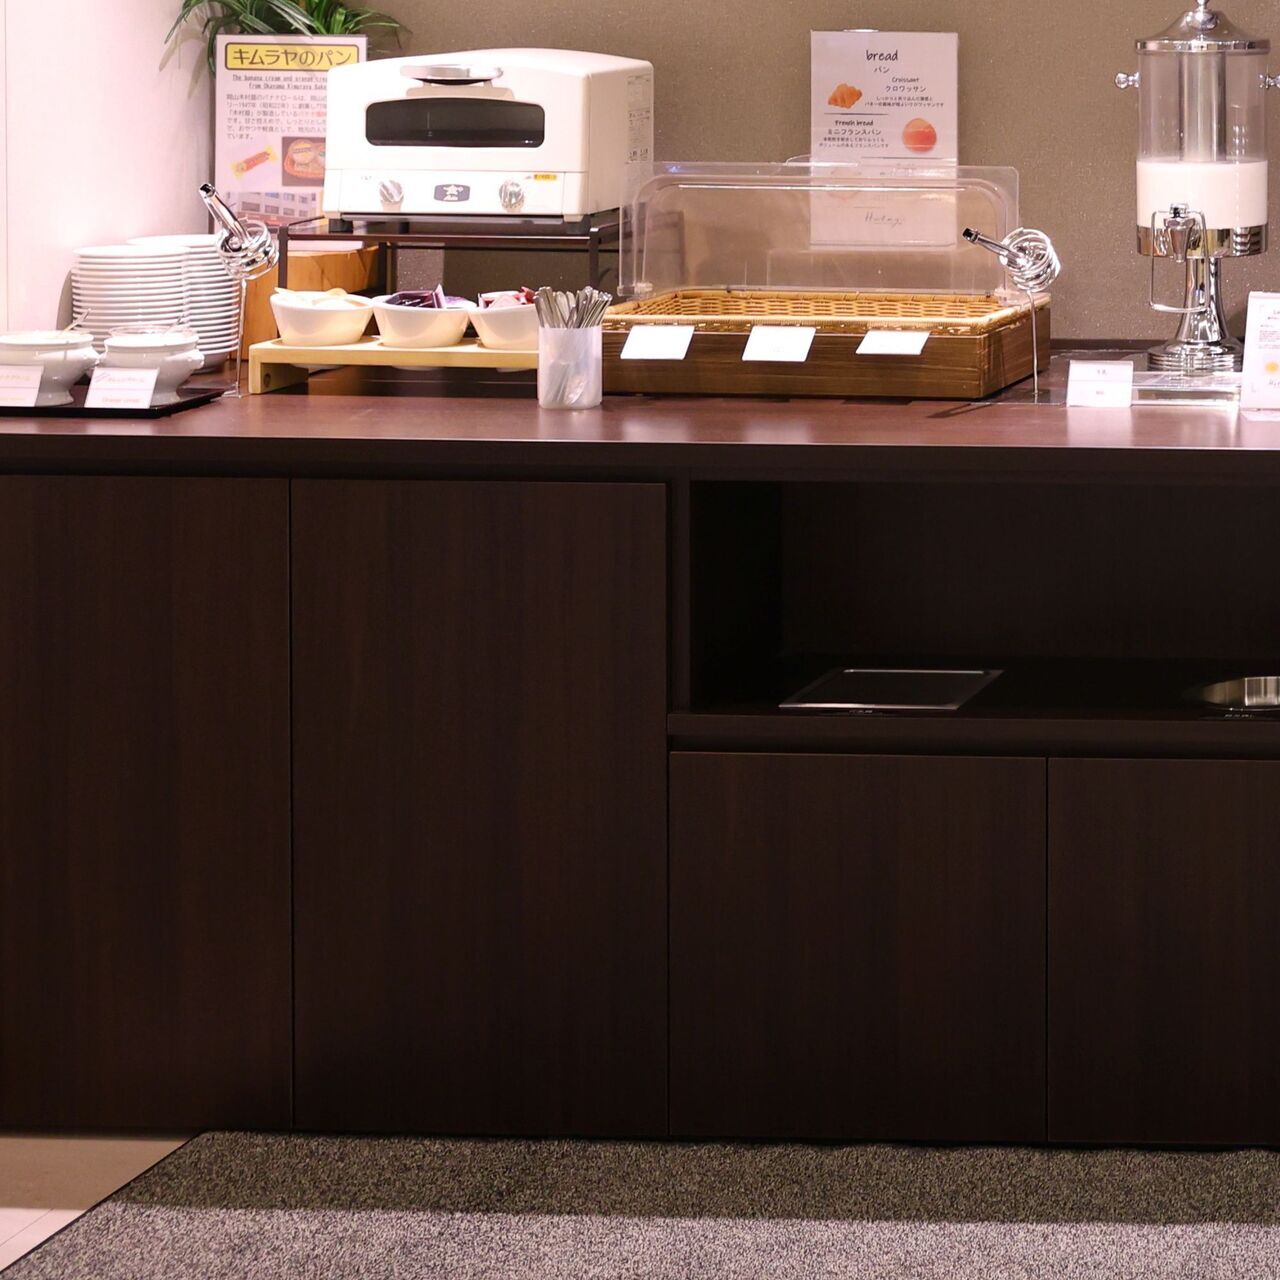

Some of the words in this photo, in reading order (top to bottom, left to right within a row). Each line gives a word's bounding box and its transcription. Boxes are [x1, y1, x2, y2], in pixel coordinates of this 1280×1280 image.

[232, 48, 352, 67] キムラヤのパン
[866, 49, 899, 62] bread
[873, 66, 891, 74] パン
[248, 82, 262, 90] from
[885, 85, 927, 93] クロワッサン
